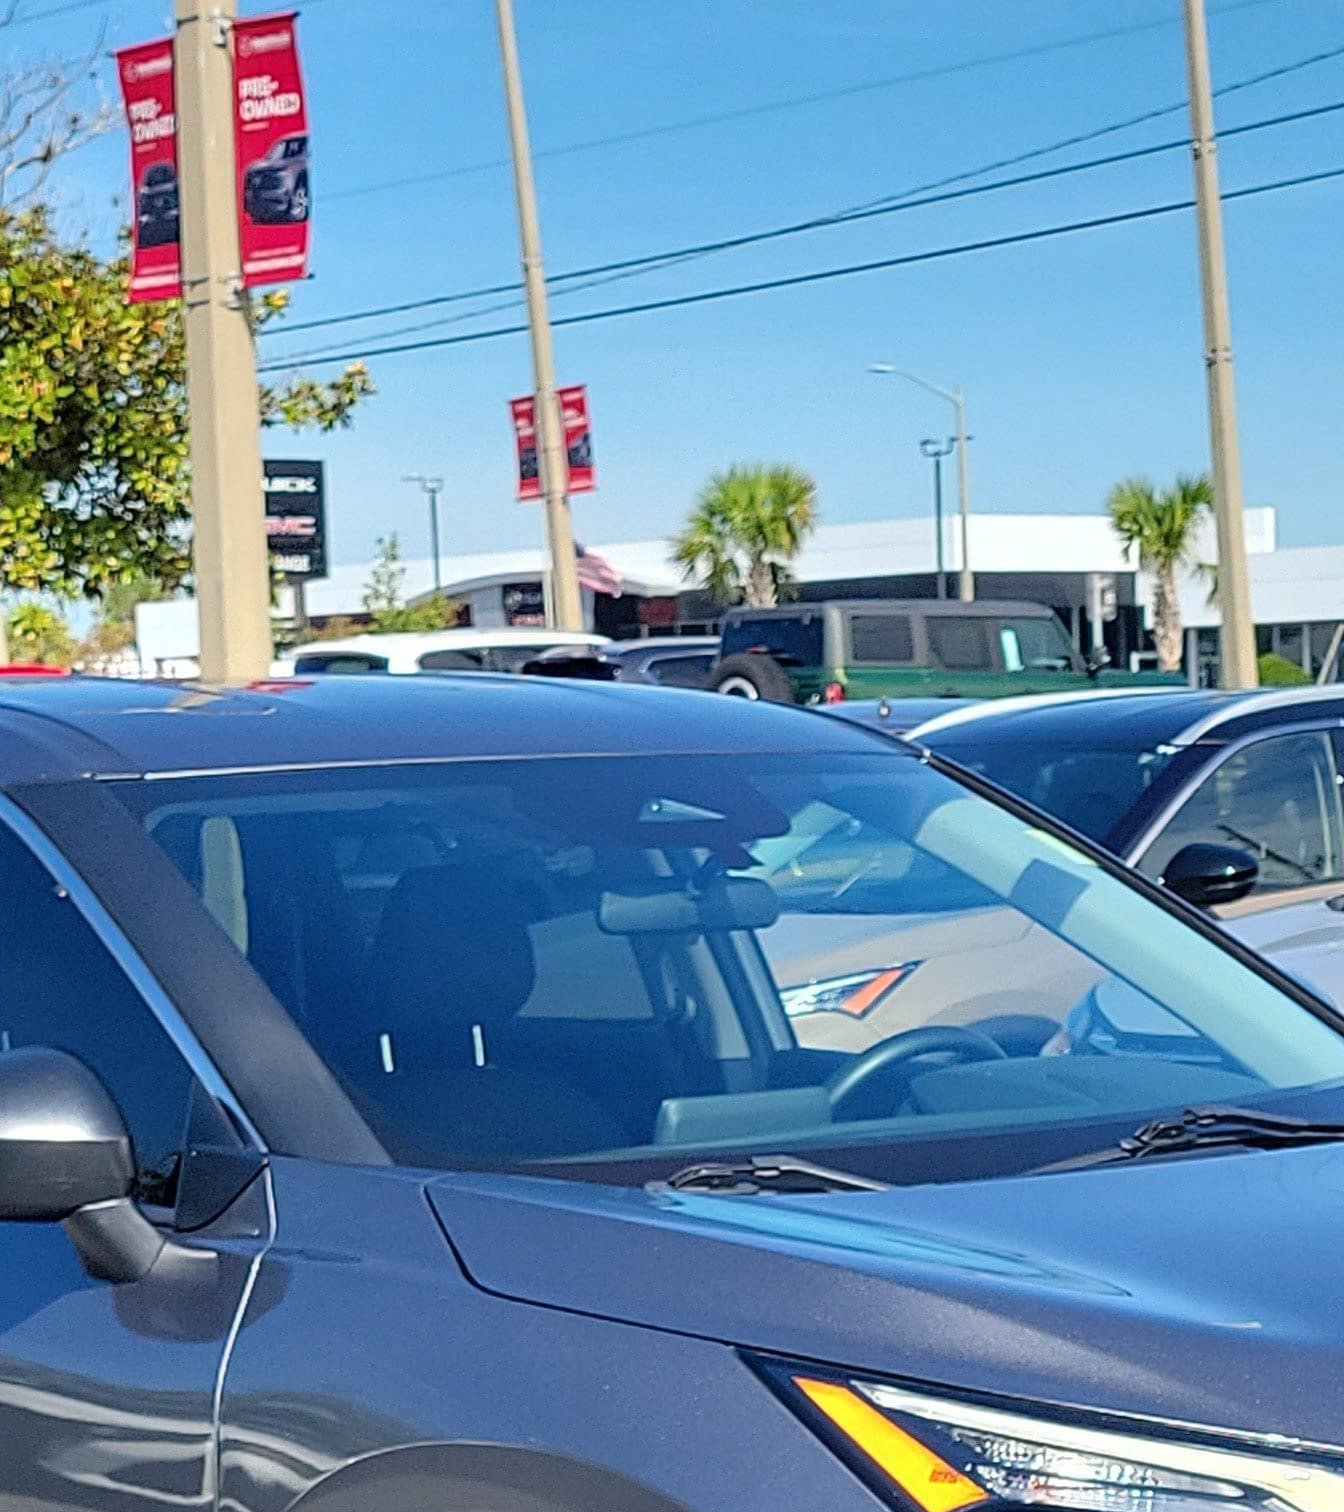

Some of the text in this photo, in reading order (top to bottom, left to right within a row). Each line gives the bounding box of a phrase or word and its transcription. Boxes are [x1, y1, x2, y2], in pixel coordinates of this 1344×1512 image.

[238, 74, 279, 99] PRE-
[239, 92, 301, 121] OWNED
[260, 476, 318, 492] UICK
